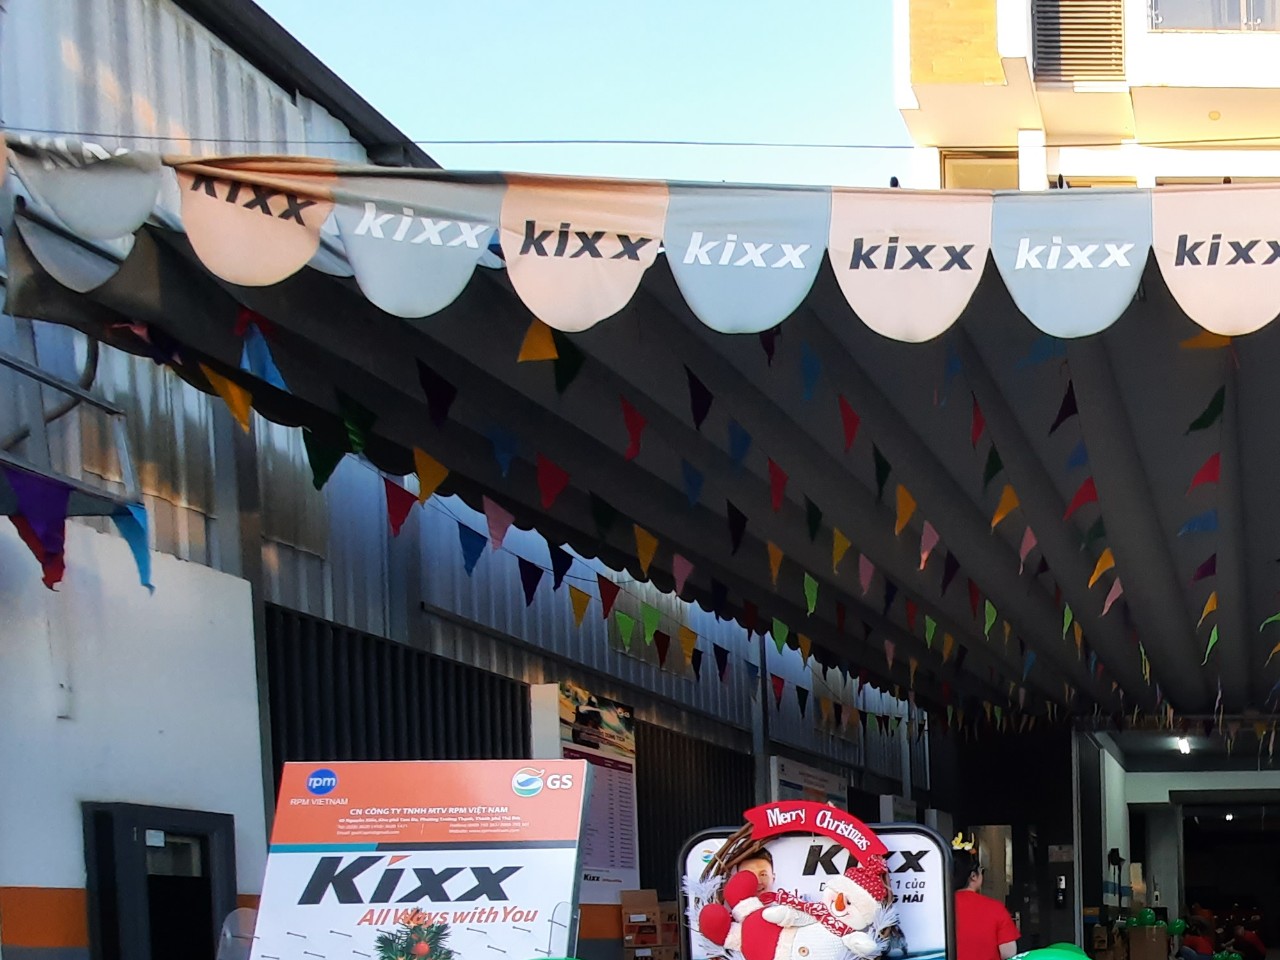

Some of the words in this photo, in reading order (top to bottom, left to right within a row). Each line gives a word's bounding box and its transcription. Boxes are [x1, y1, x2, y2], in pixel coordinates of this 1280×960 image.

[354, 202, 491, 249] kixx
[519, 220, 652, 262] kixx
[682, 231, 812, 269] kixx
[848, 236, 975, 271] kixx
[1014, 236, 1136, 270] kixx
[308, 775, 336, 789] rpm
[546, 774, 573, 790] GS
[290, 798, 310, 806] RPM
[311, 797, 348, 806] VIETNAM
[365, 806, 390, 815] CÔNG
[403, 807, 427, 815] TNHH
[428, 807, 449, 815] MTV
[449, 807, 468, 815] RPM
[468, 805, 488, 816] VIỆT
[488, 806, 509, 814] NAM
[766, 807, 807, 828] Merry
[815, 810, 871, 852] Christmas
[297, 854, 525, 906] Kixx
[904, 879, 926, 890] của
[357, 908, 391, 926] All
[391, 907, 450, 927] Ways
[452, 906, 498, 925] with
[498, 905, 539, 924] You
